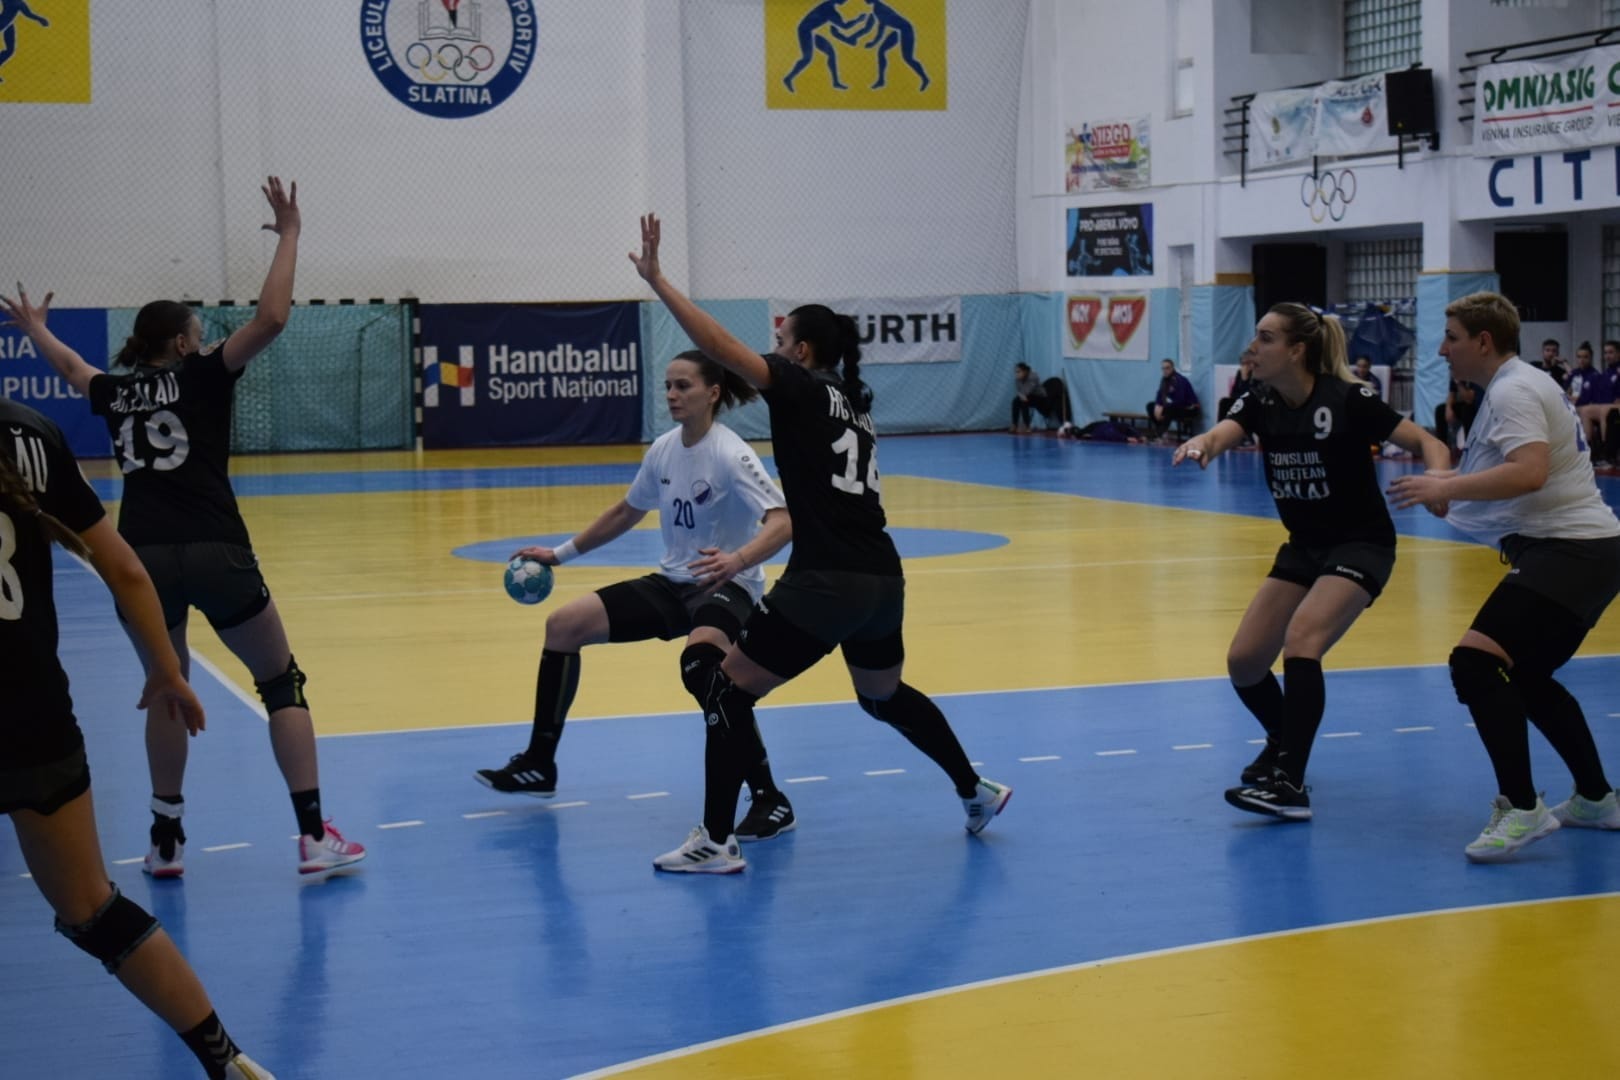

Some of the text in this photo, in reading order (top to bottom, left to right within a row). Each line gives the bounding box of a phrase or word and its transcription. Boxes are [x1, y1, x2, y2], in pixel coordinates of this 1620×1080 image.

[365, 0, 392, 71] LICEUL
[408, 85, 492, 104] SLATINA
[1482, 65, 1595, 112] OMNIASIG
[1482, 115, 1594, 140] VIENNA INSURANCE GROUP
[856, 313, 957, 344] ÜRTH
[488, 342, 637, 374] Handbalul
[488, 375, 638, 404] Sport Național
[1313, 406, 1333, 440] 9
[114, 410, 190, 474] 19
[673, 498, 695, 530] 20
